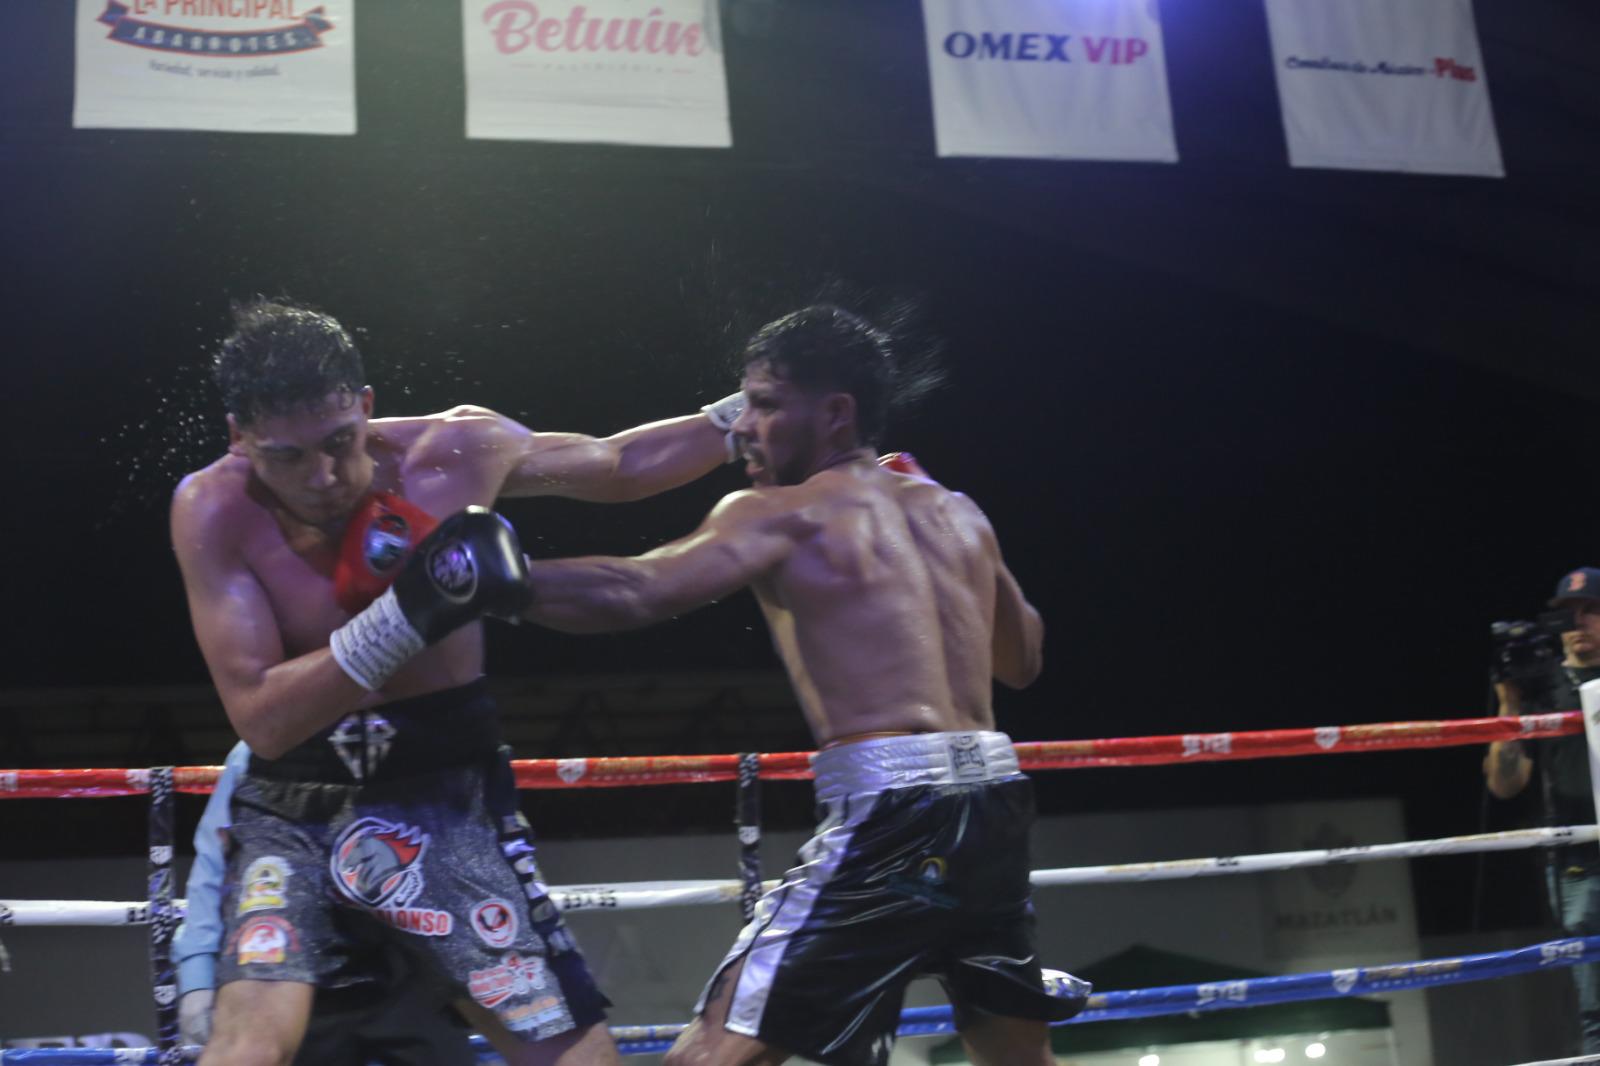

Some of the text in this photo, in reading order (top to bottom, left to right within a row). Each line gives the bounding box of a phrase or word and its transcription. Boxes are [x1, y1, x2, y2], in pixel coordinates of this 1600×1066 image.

[164, 0, 303, 19] PRINCIPAL
[133, 26, 298, 52] ABARROTES
[943, 31, 1149, 65] OMEX VIP
